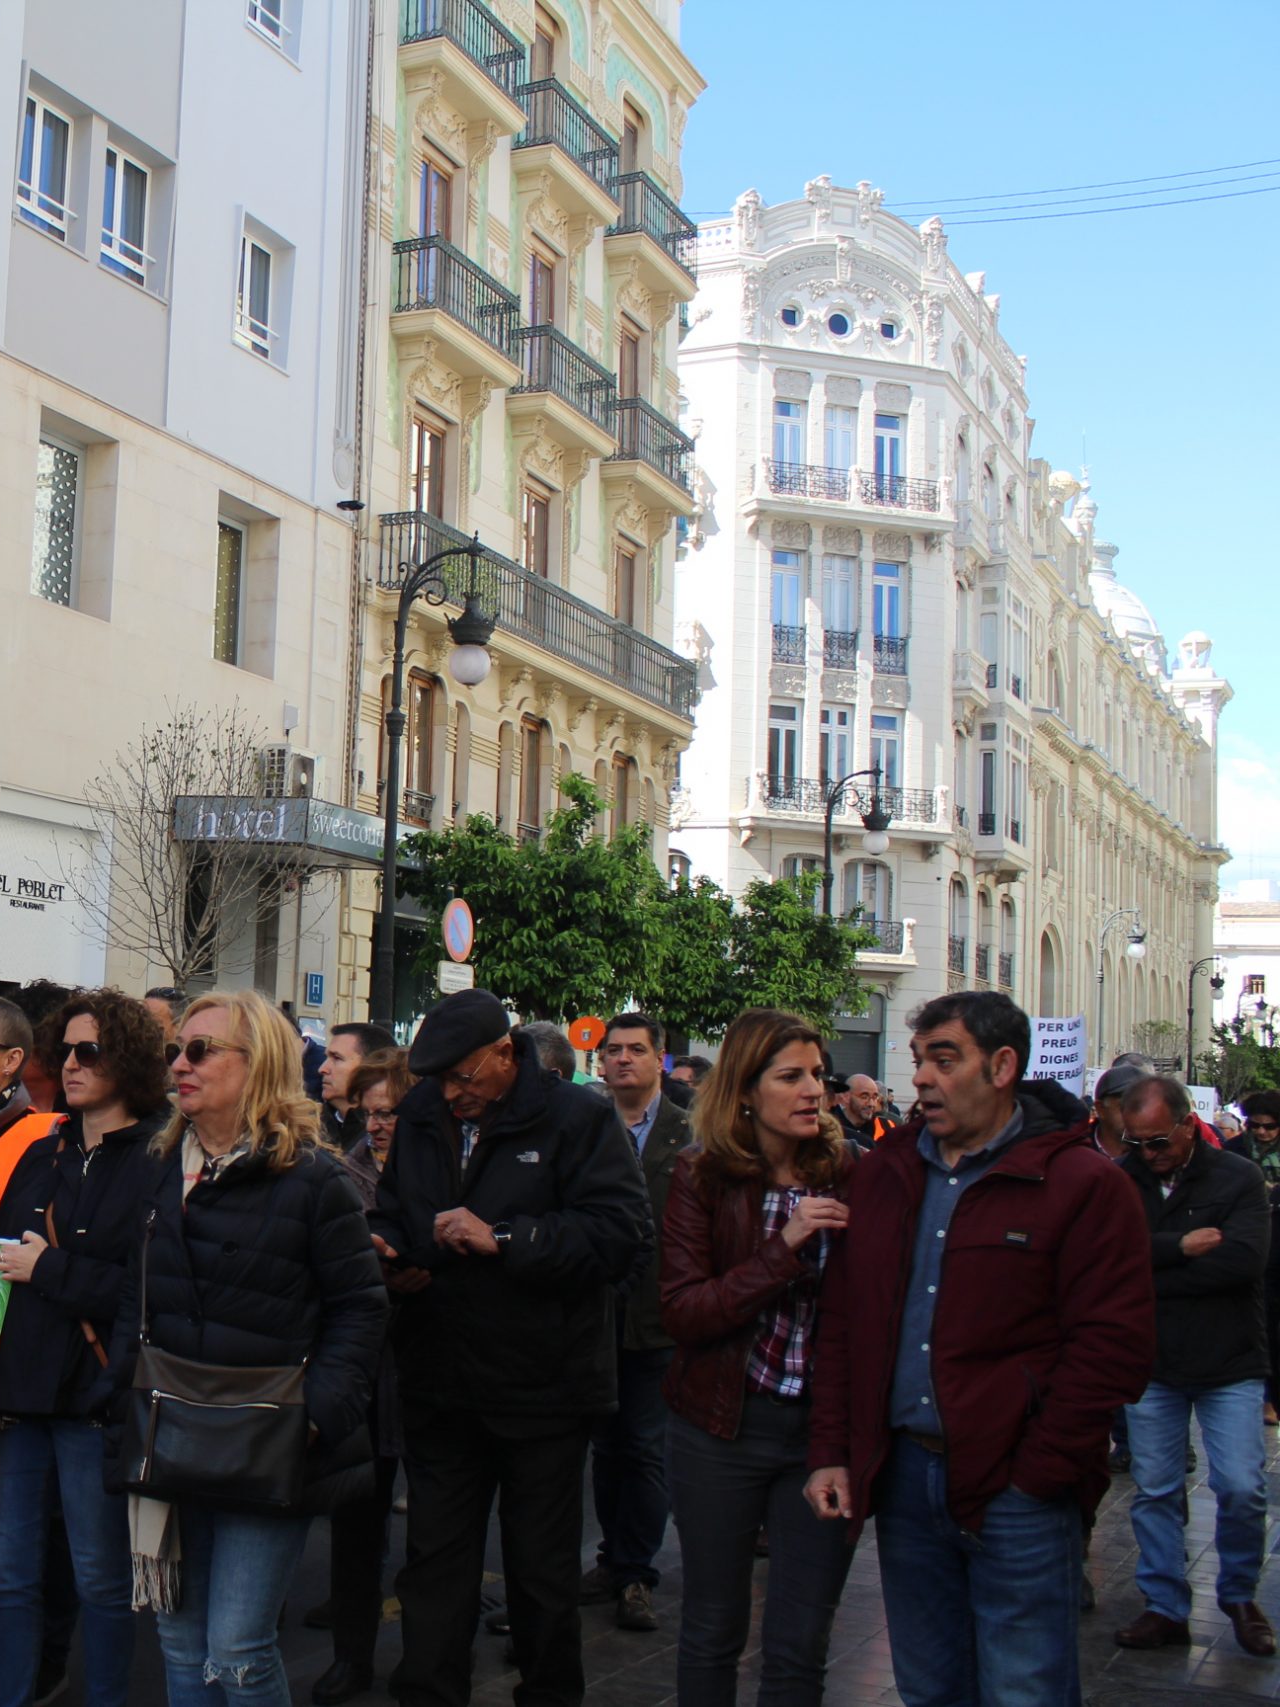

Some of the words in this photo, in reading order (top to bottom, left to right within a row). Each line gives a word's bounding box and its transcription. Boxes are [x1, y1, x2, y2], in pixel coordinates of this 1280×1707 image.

[193, 803, 286, 840] hotel
[17, 878, 65, 901] POBLET
[312, 976, 321, 994] H
[1038, 1022, 1064, 1031] PER
[1042, 1037, 1077, 1048] PREUS
[1040, 1052, 1079, 1064] DIGNES
